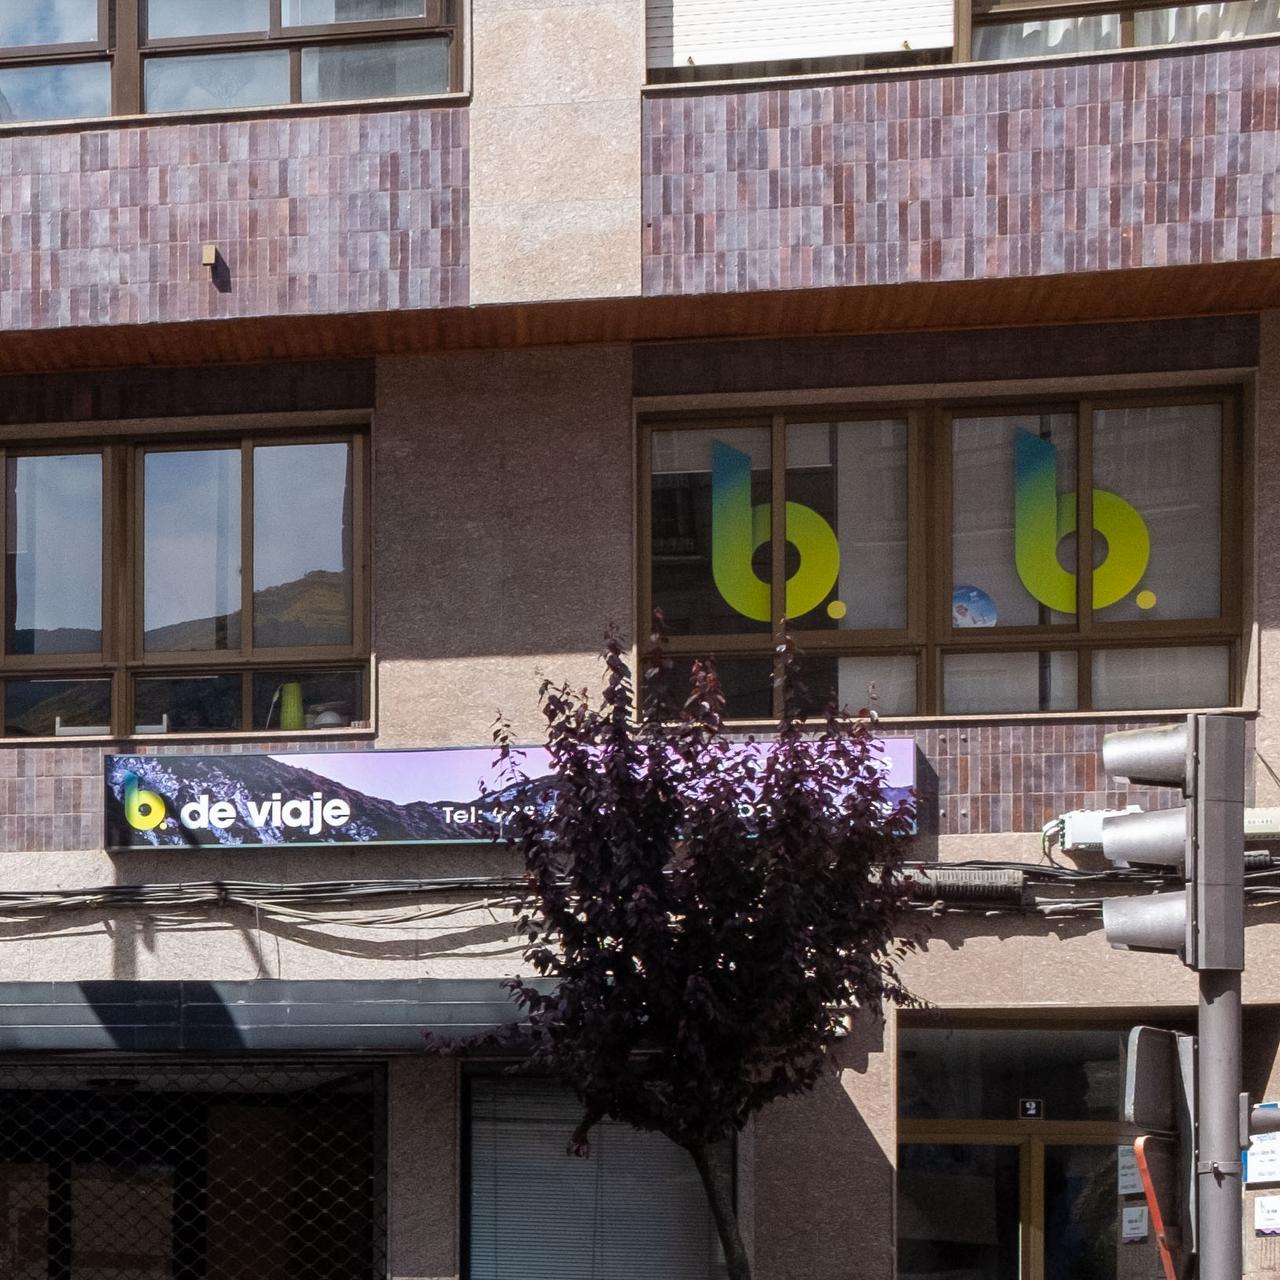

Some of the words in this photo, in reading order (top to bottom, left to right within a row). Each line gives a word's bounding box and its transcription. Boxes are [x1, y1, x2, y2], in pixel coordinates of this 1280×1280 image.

[180, 794, 236, 829] de
[246, 792, 351, 835] viaje
[443, 805, 484, 824] Tel:
[1025, 1101, 1037, 1115] 2
